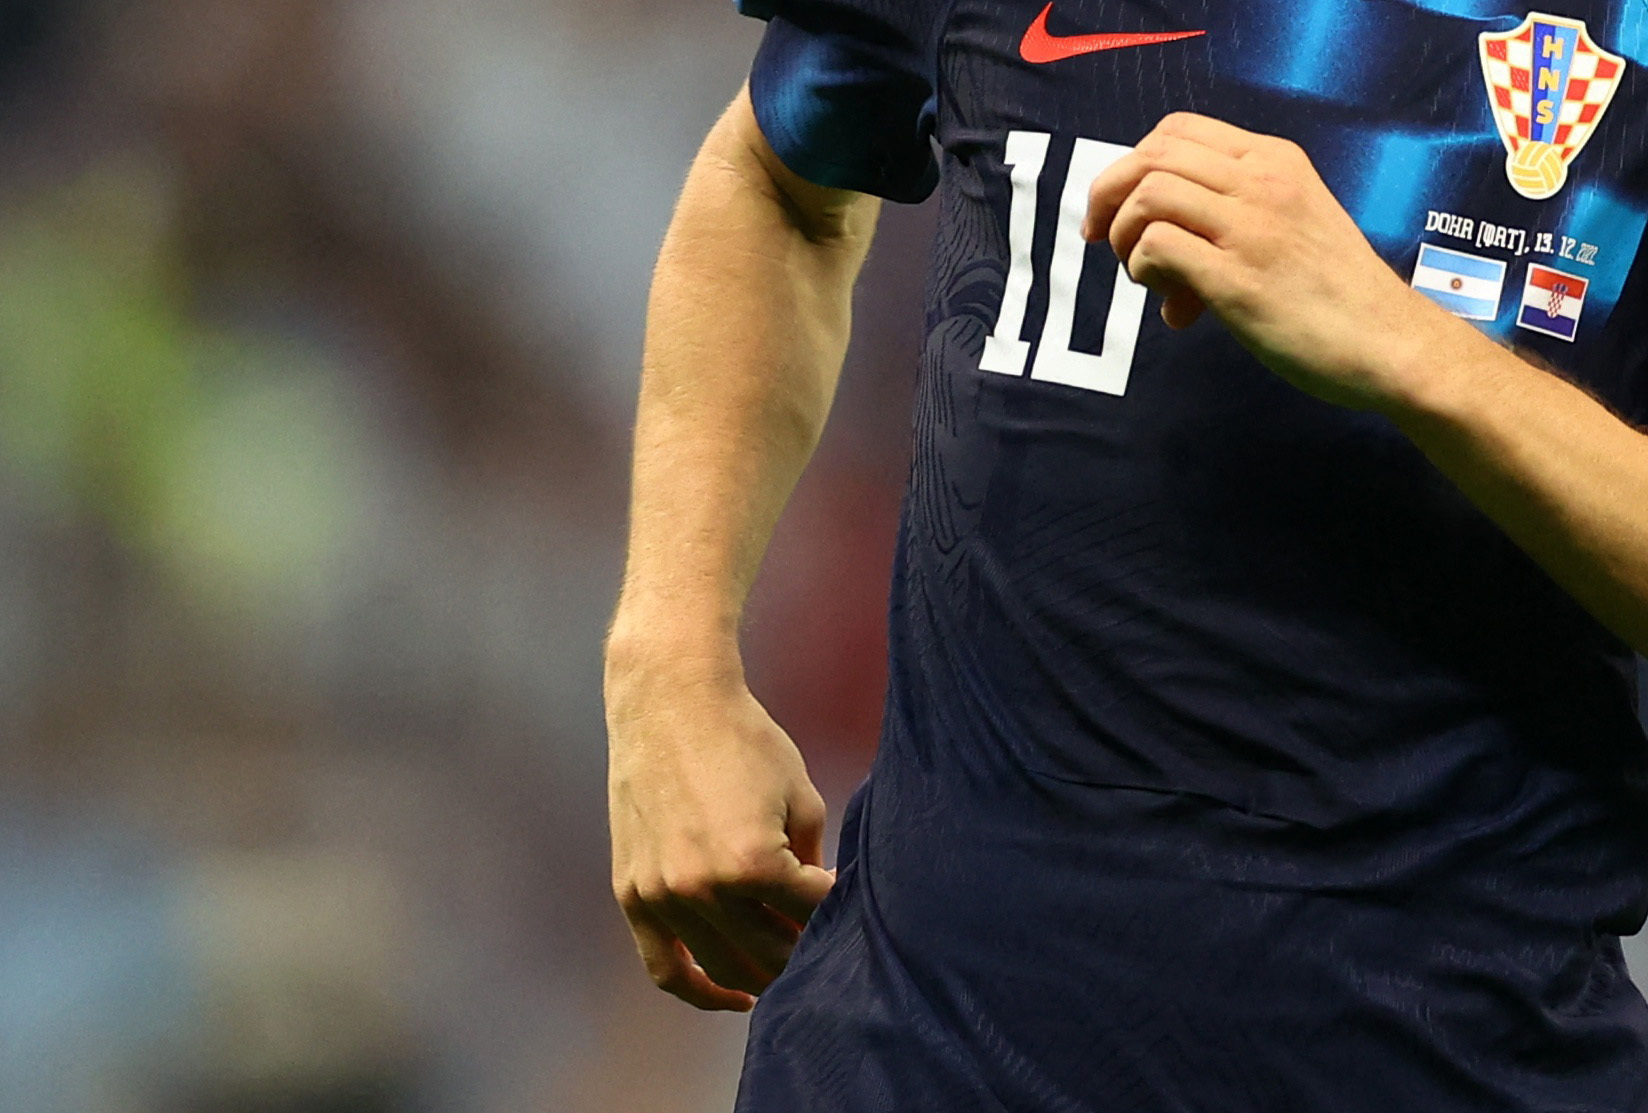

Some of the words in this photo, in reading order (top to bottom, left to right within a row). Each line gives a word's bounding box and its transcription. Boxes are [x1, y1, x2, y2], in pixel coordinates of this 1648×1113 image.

[1536, 34, 1565, 125] HNS
[978, 130, 1148, 397] 10
[1424, 209, 1475, 240] DOHA
[1534, 232, 1555, 255] 13.
